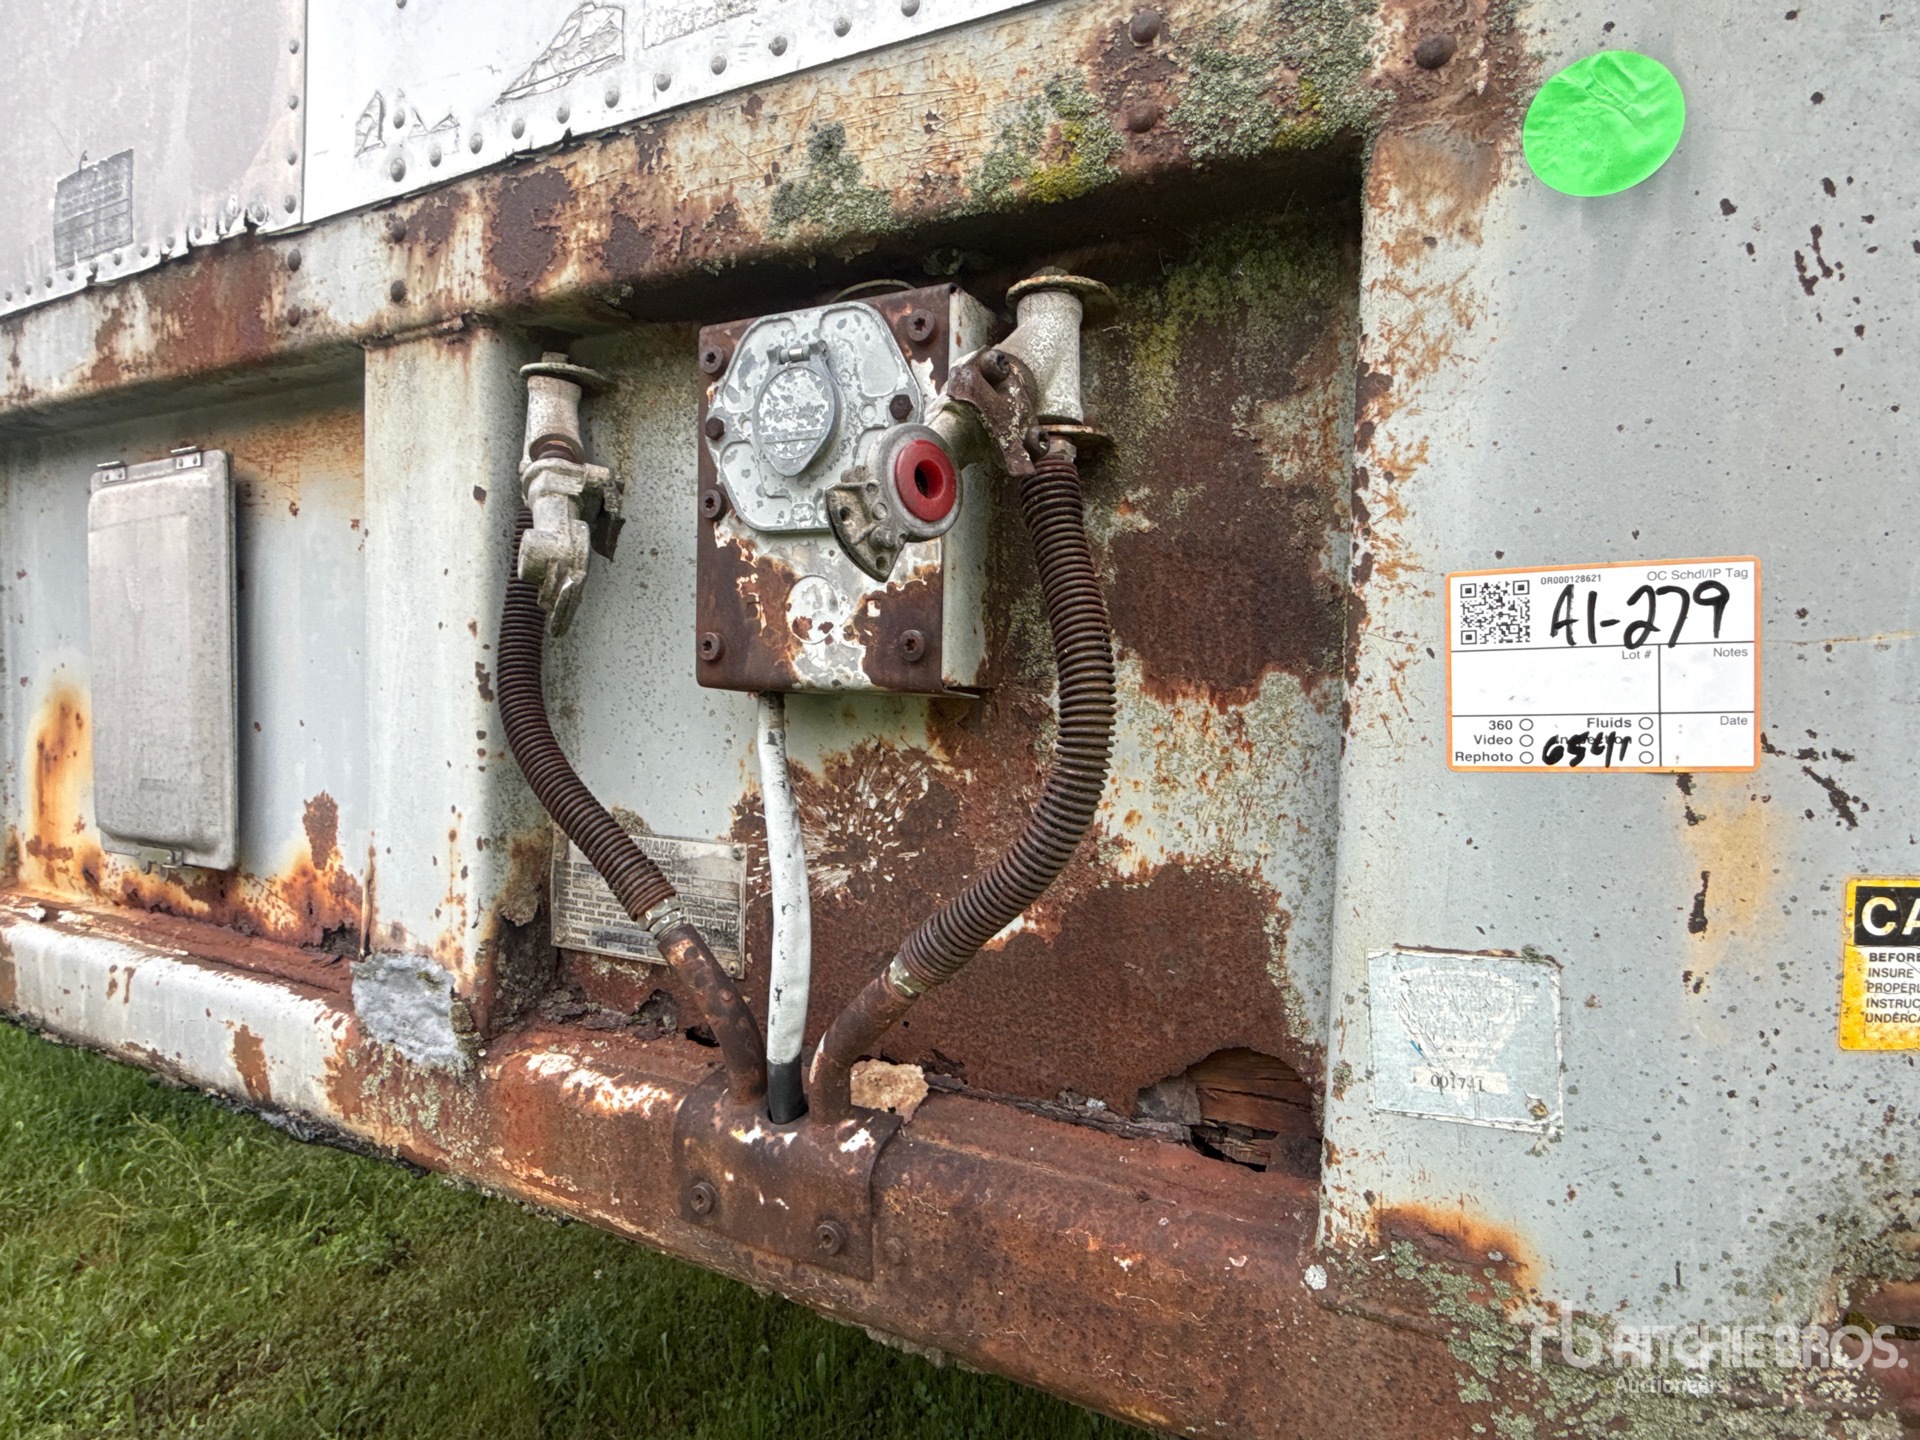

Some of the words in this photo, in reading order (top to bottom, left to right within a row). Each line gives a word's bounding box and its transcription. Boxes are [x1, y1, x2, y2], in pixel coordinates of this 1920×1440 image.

[1647, 571, 1667, 581] OC
[1726, 568, 1749, 580] Tag
[1622, 650, 1641, 660] Lot
[1644, 650, 1652, 659] #
[1713, 647, 1748, 658] Notes
[1488, 719, 1513, 731] 360
[1587, 716, 1632, 729] Fluids
[1720, 716, 1748, 726] Date
[1474, 733, 1513, 746] Video
[1455, 750, 1513, 764] Rephoto
[1868, 967, 1914, 979] INSURE
